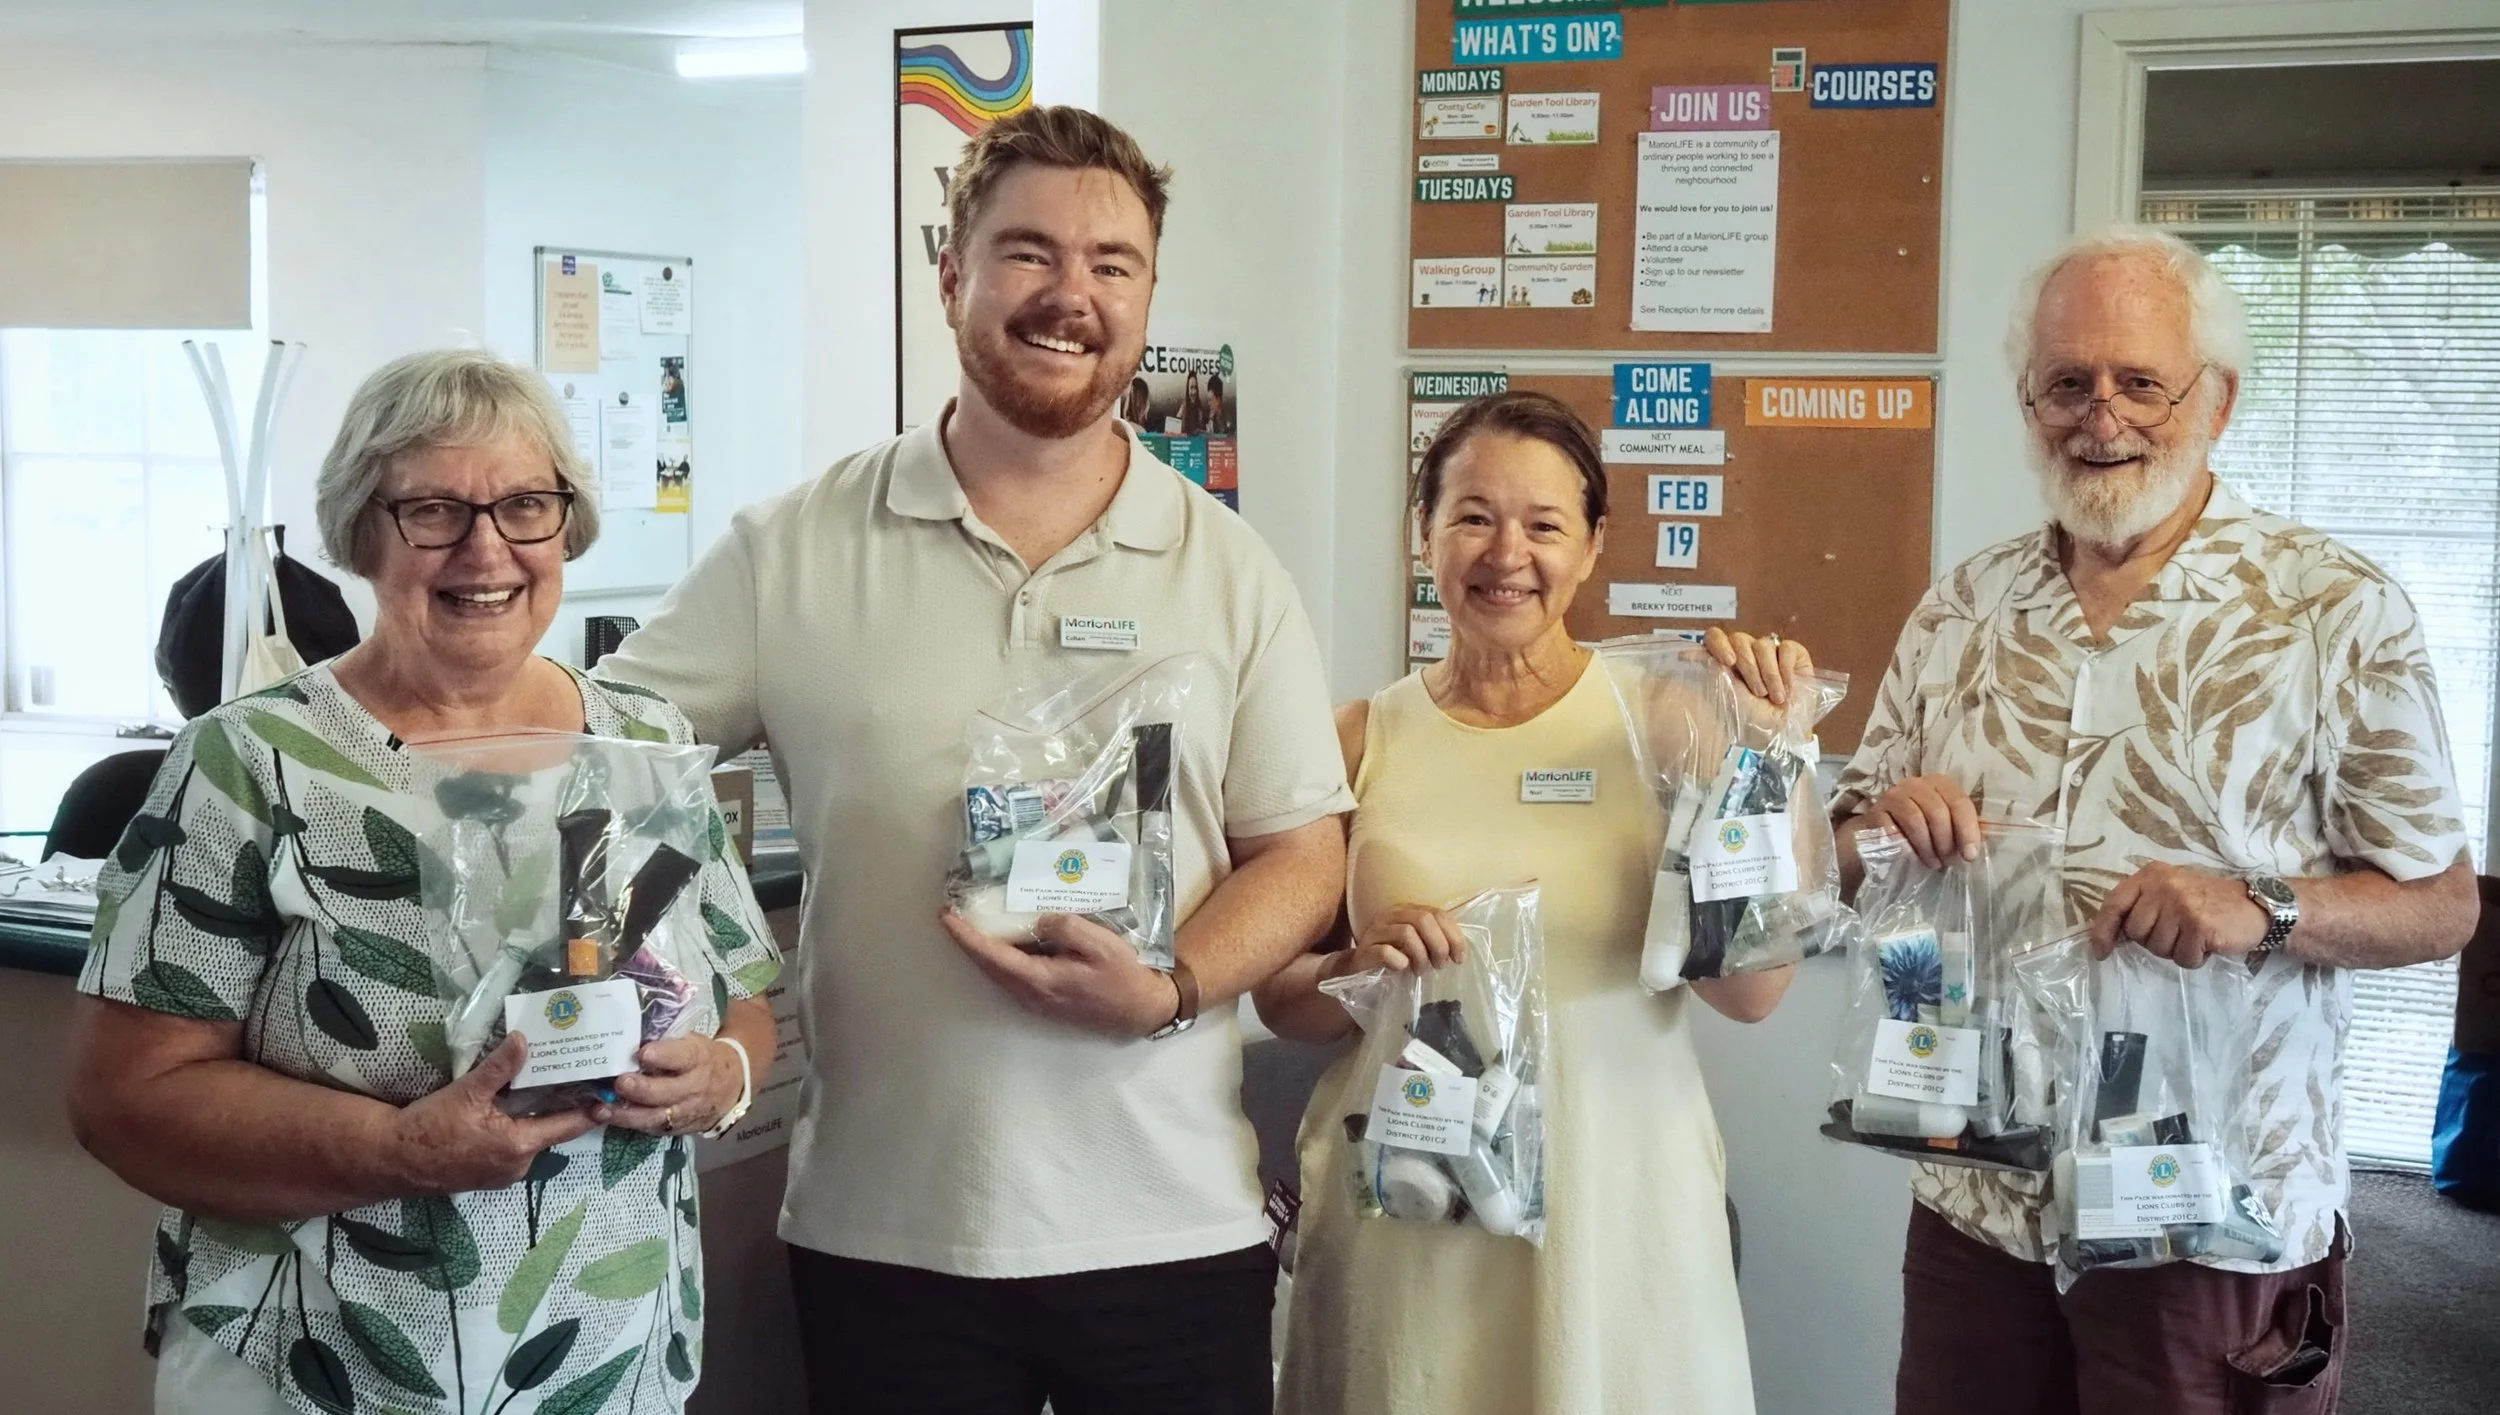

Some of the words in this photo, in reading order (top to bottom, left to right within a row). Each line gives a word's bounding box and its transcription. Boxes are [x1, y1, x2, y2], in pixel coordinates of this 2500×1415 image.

[1460, 23, 1557, 56] WHAT'S
[1567, 21, 1617, 53] ON?
[1422, 70, 1501, 92] MONDAYS
[1814, 70, 1934, 101] COURSES
[1510, 99, 1543, 107] Garden
[1546, 98, 1564, 106] Tool
[1566, 97, 1597, 108] Library
[1660, 92, 1718, 122] JOIN
[1728, 91, 1761, 121] US
[1648, 140, 1693, 149] MarionLIFE
[1696, 140, 1703, 148] is
[1713, 140, 1758, 149] community
[1761, 139, 1769, 148] of
[1643, 152, 1674, 162] ordinary
[1676, 152, 1703, 161] people
[1706, 151, 1738, 161] working
[1661, 164, 1690, 174] thriving
[1692, 164, 1707, 172] and
[1710, 164, 1753, 172] connected
[1675, 176, 1737, 186] neighbourhood
[1420, 177, 1513, 200] TUESDAYS
[1507, 209, 1541, 217] Garden
[1543, 209, 1562, 217] Tool
[1563, 208, 1595, 218] Library
[1654, 204, 1678, 212] would
[1680, 204, 1697, 212] love
[1699, 204, 1711, 212] for
[1713, 206, 1729, 214] you
[1741, 204, 1758, 214] join
[1760, 204, 1773, 212] us!
[1646, 232, 1657, 240] Be
[1659, 233, 1675, 241] part
[1677, 232, 1685, 240] of
[1694, 232, 1741, 240] MarionLIFE
[1744, 234, 1768, 242] group
[1646, 244, 1671, 252] Attend
[1645, 256, 1684, 264] Volunteer
[1419, 265, 1460, 277] Walking
[1462, 265, 1496, 275] Group
[1507, 263, 1558, 273] Community
[1560, 263, 1593, 271] Garden
[1645, 267, 1663, 276] Sign
[1702, 267, 1745, 276] newsletter
[1640, 305, 1656, 313] See
[1658, 305, 1698, 315] Reception
[1701, 305, 1711, 314] for
[1737, 306, 1765, 315] details
[1139, 346, 1168, 373] CE
[1169, 357, 1221, 375] COURSES
[1632, 367, 1693, 393] COME
[1414, 376, 1507, 396] WEDNESDAYS
[1762, 387, 1866, 419] COMING
[1877, 388, 1913, 419] UP
[1625, 398, 1699, 423] ALONG
[1651, 433, 1672, 441] NEXT
[1620, 444, 1677, 453] COMMUNITY
[1679, 444, 1705, 454] MEAL
[1658, 481, 1708, 510] FEB
[1667, 526, 1694, 556] 19
[1661, 588, 1683, 596] NEXT
[1631, 602, 1665, 611] BREKKY
[1667, 603, 1713, 612] TOGETHER
[1065, 618, 1136, 630] MarionLIFE
[1526, 771, 1592, 781] MarionLIFE
[1744, 875, 1769, 885] 201C2
[575, 1057, 609, 1068] 201C2
[736, 1117, 783, 1142] MarionLIFE
[1420, 1134, 1447, 1144] 201C2
[2172, 1213, 2198, 1222] 201C2
